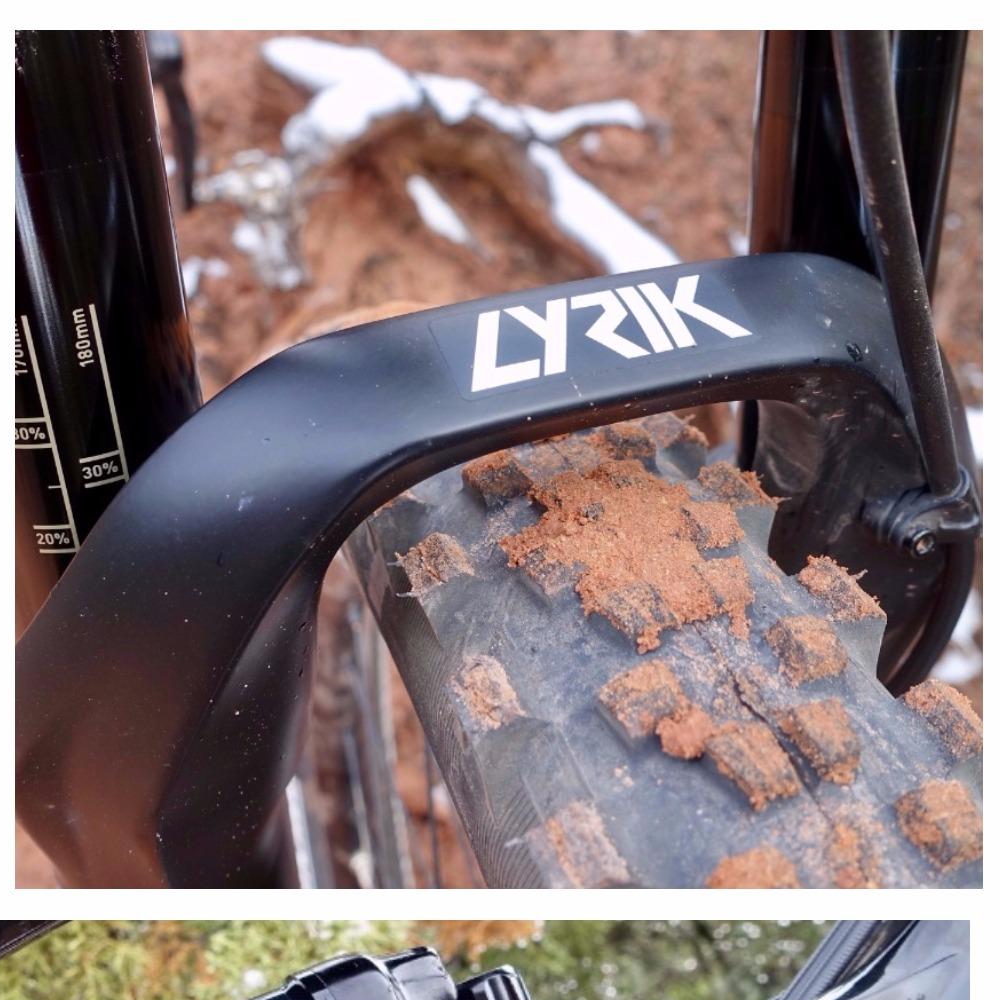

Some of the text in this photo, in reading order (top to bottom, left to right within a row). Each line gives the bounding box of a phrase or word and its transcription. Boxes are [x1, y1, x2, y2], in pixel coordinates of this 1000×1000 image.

[72, 307, 95, 368] 180mm
[471, 274, 753, 393] LYRIK
[81, 460, 119, 480] 30%
[36, 532, 71, 546] 20%
